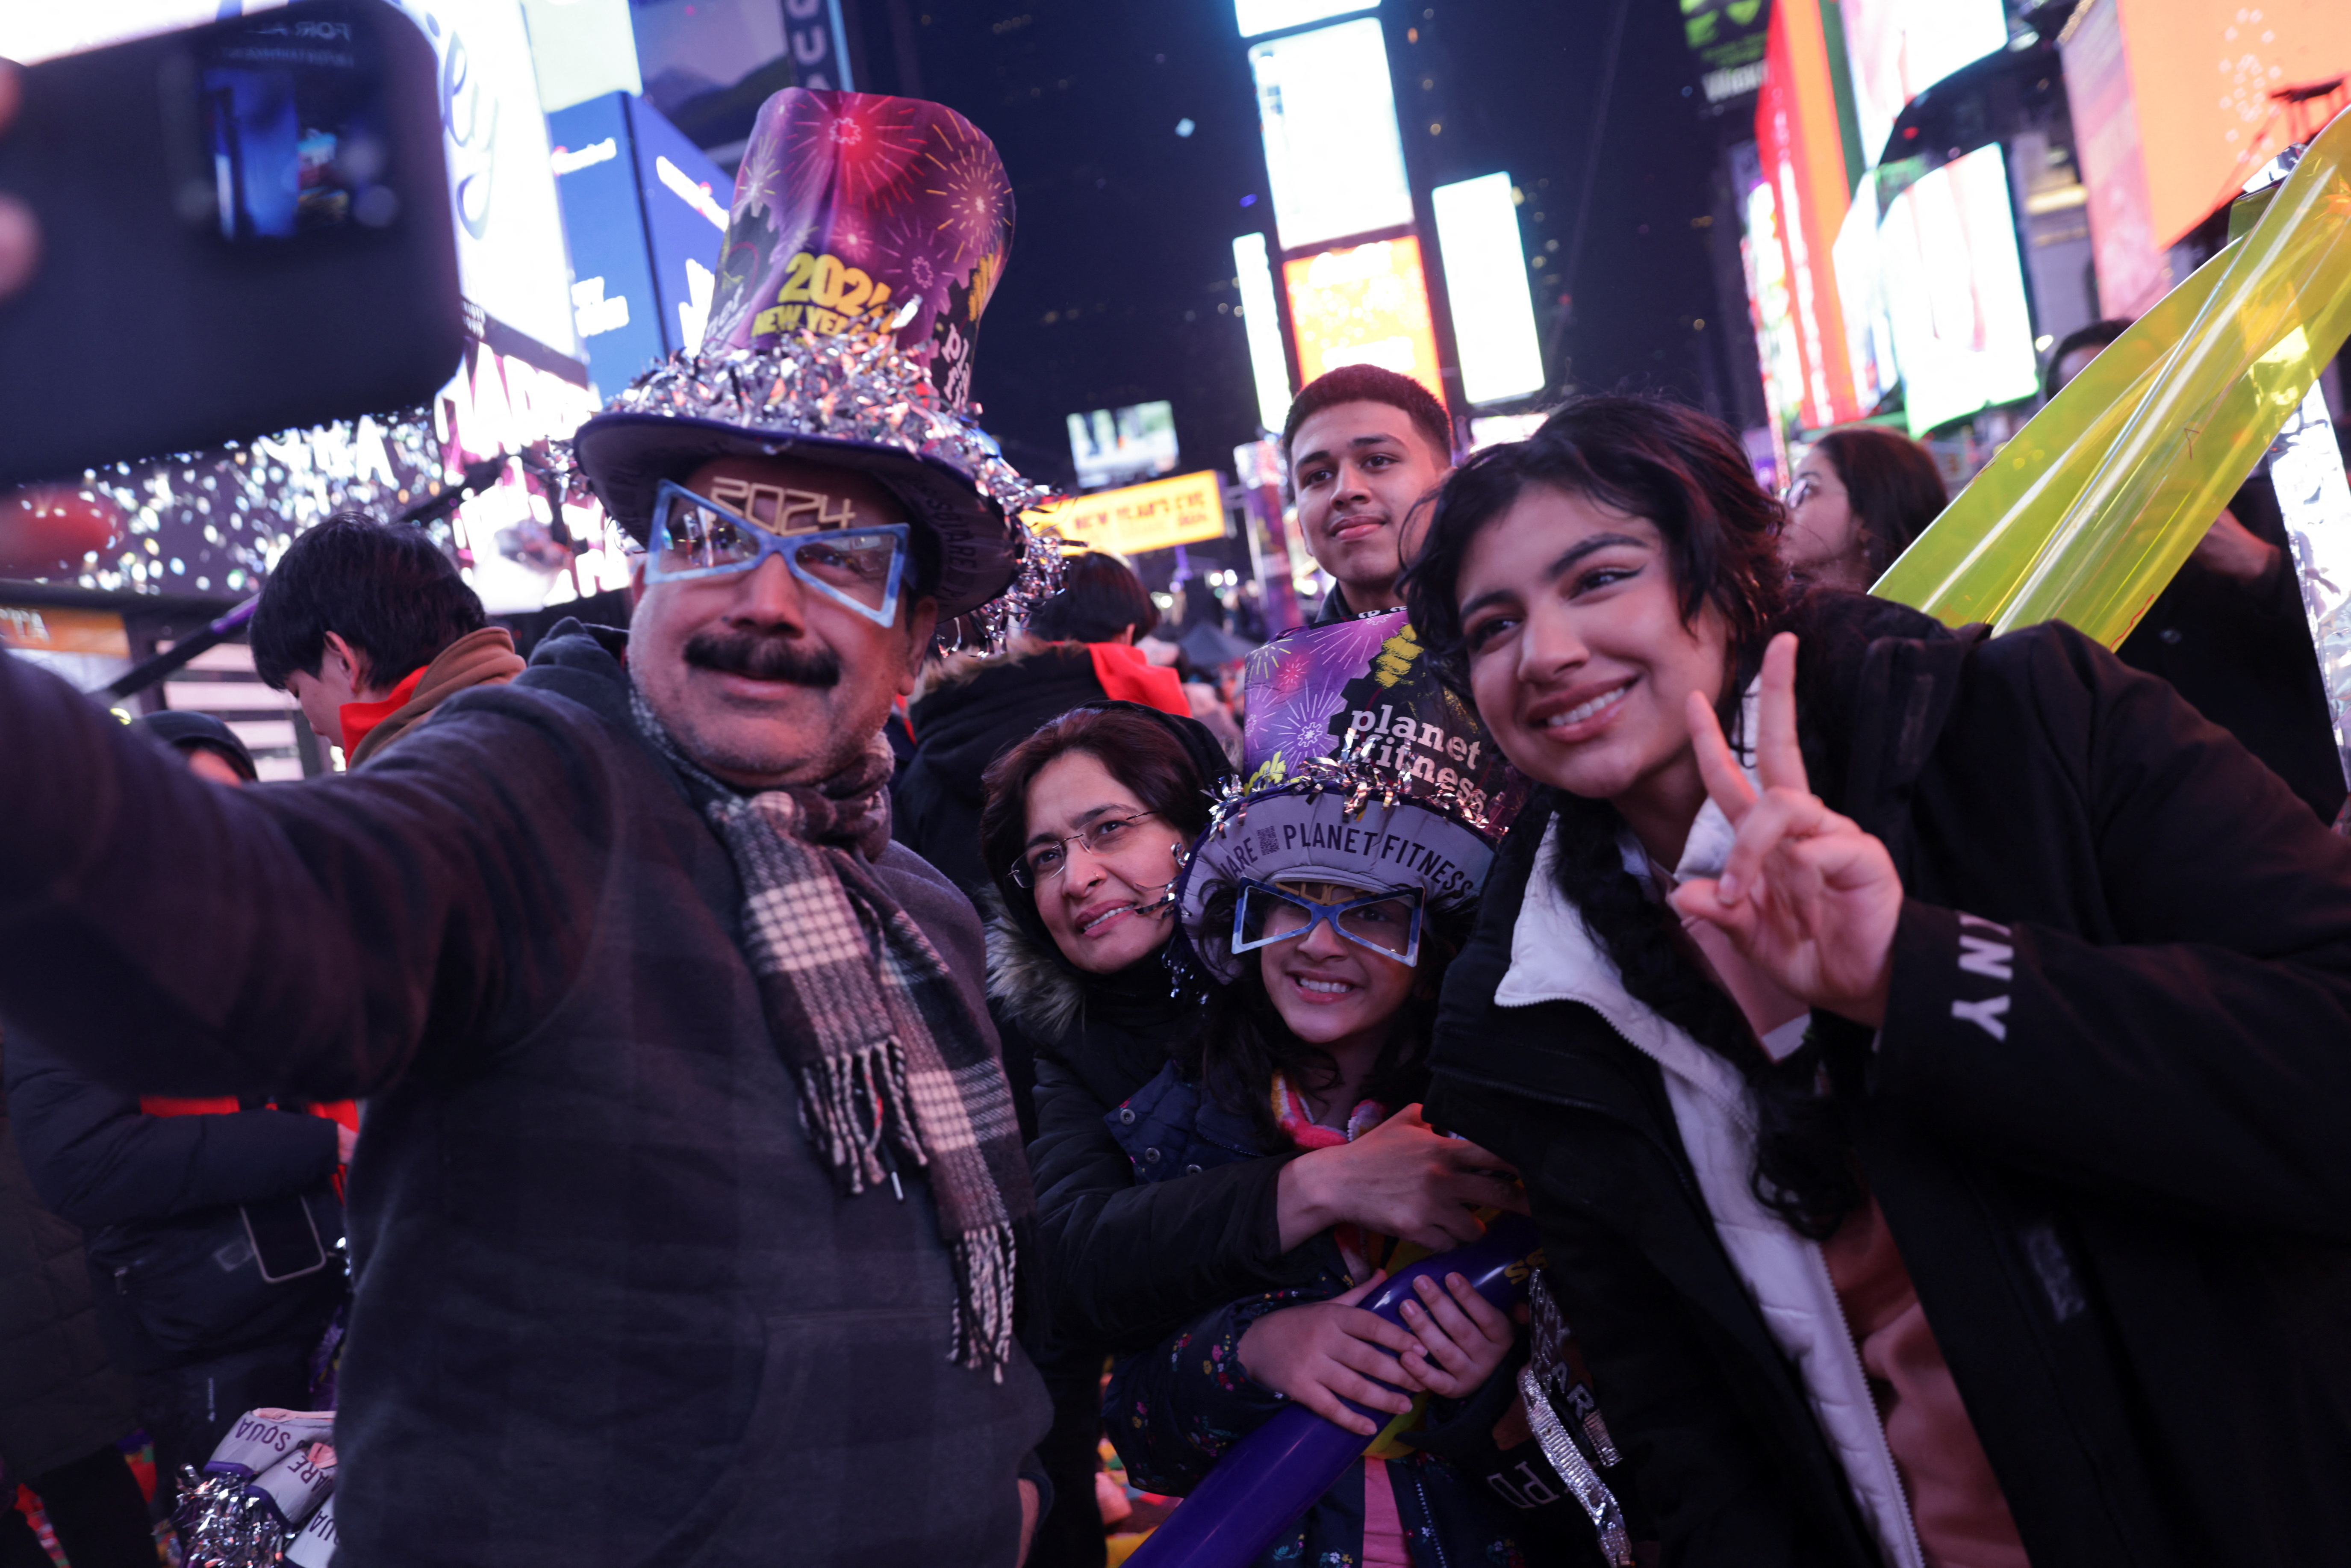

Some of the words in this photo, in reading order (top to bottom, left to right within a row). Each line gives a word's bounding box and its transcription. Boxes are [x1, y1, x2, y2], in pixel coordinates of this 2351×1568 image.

[751, 304, 804, 337] NEW
[710, 475, 855, 536] 2024
[1345, 704, 1481, 769] planet
[1283, 822, 1378, 856] PLANET
[1381, 834, 1474, 899] FITNESS
